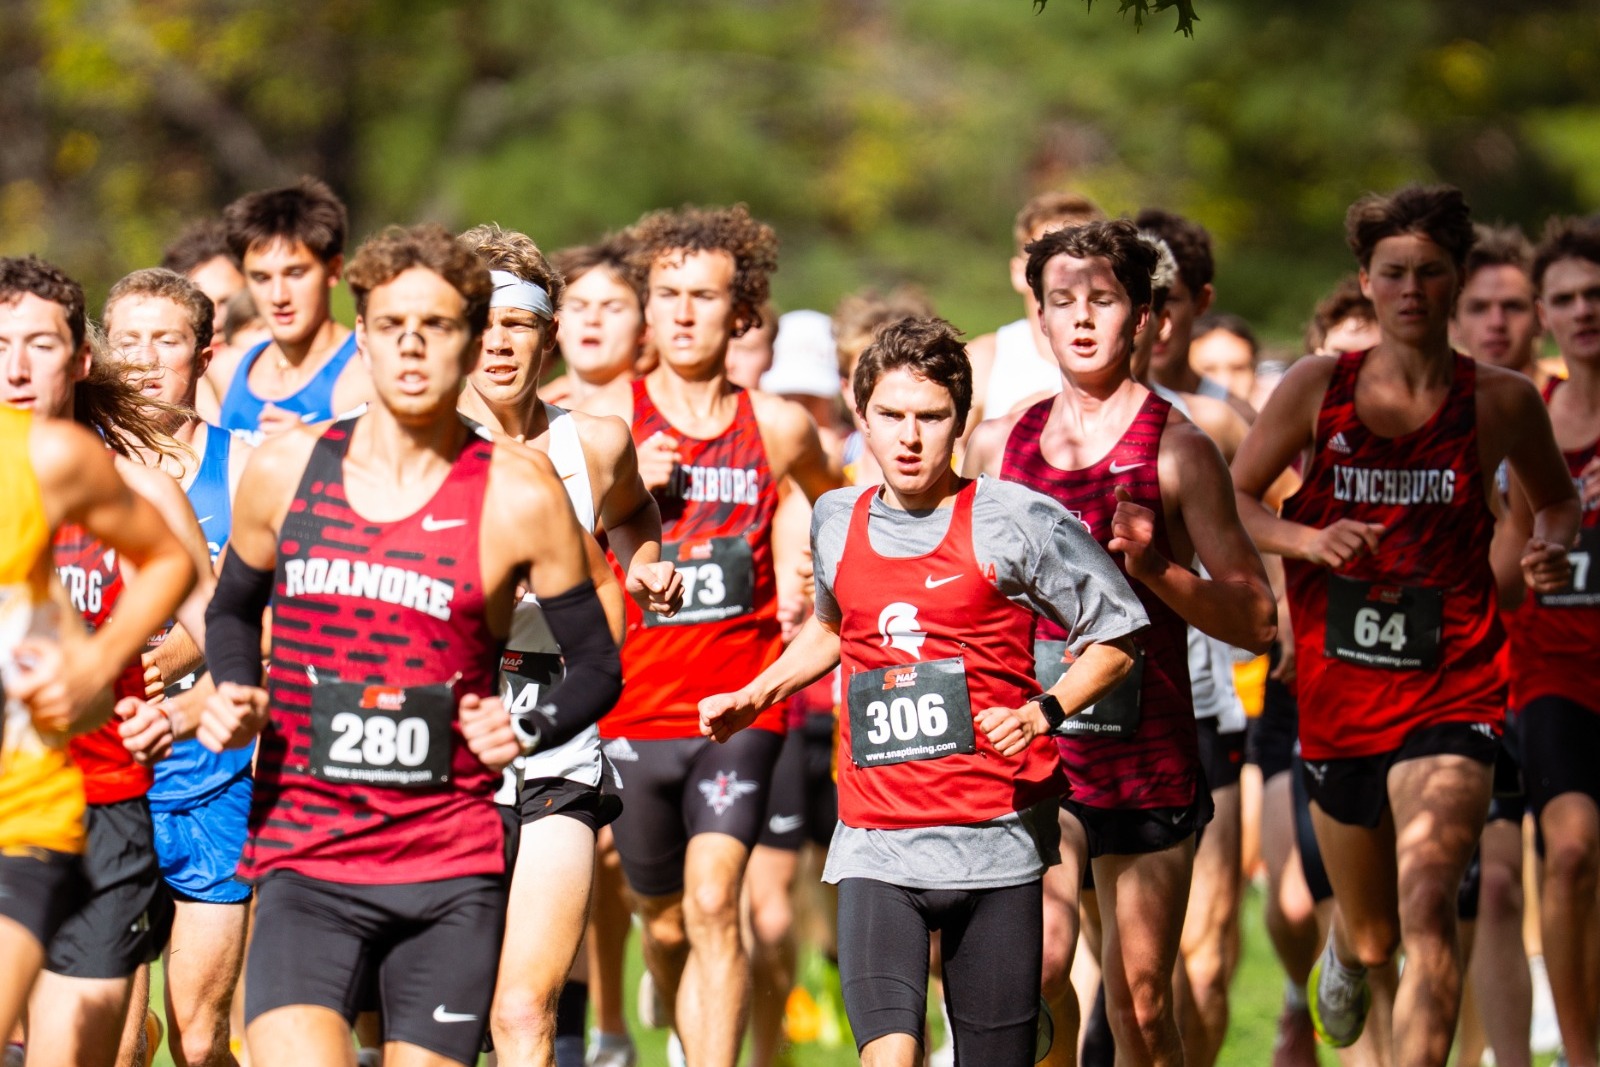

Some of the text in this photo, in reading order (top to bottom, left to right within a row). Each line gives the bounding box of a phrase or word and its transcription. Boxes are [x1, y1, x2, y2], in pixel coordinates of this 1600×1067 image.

[1333, 464, 1456, 505] LYNCHBURG
[285, 558, 454, 622] ROANOKE
[1354, 607, 1408, 651] 64
[882, 666, 918, 691] SNAP
[329, 712, 430, 767] 280
[866, 693, 949, 745] 306
[865, 742, 957, 761] www.snaptiming.com
